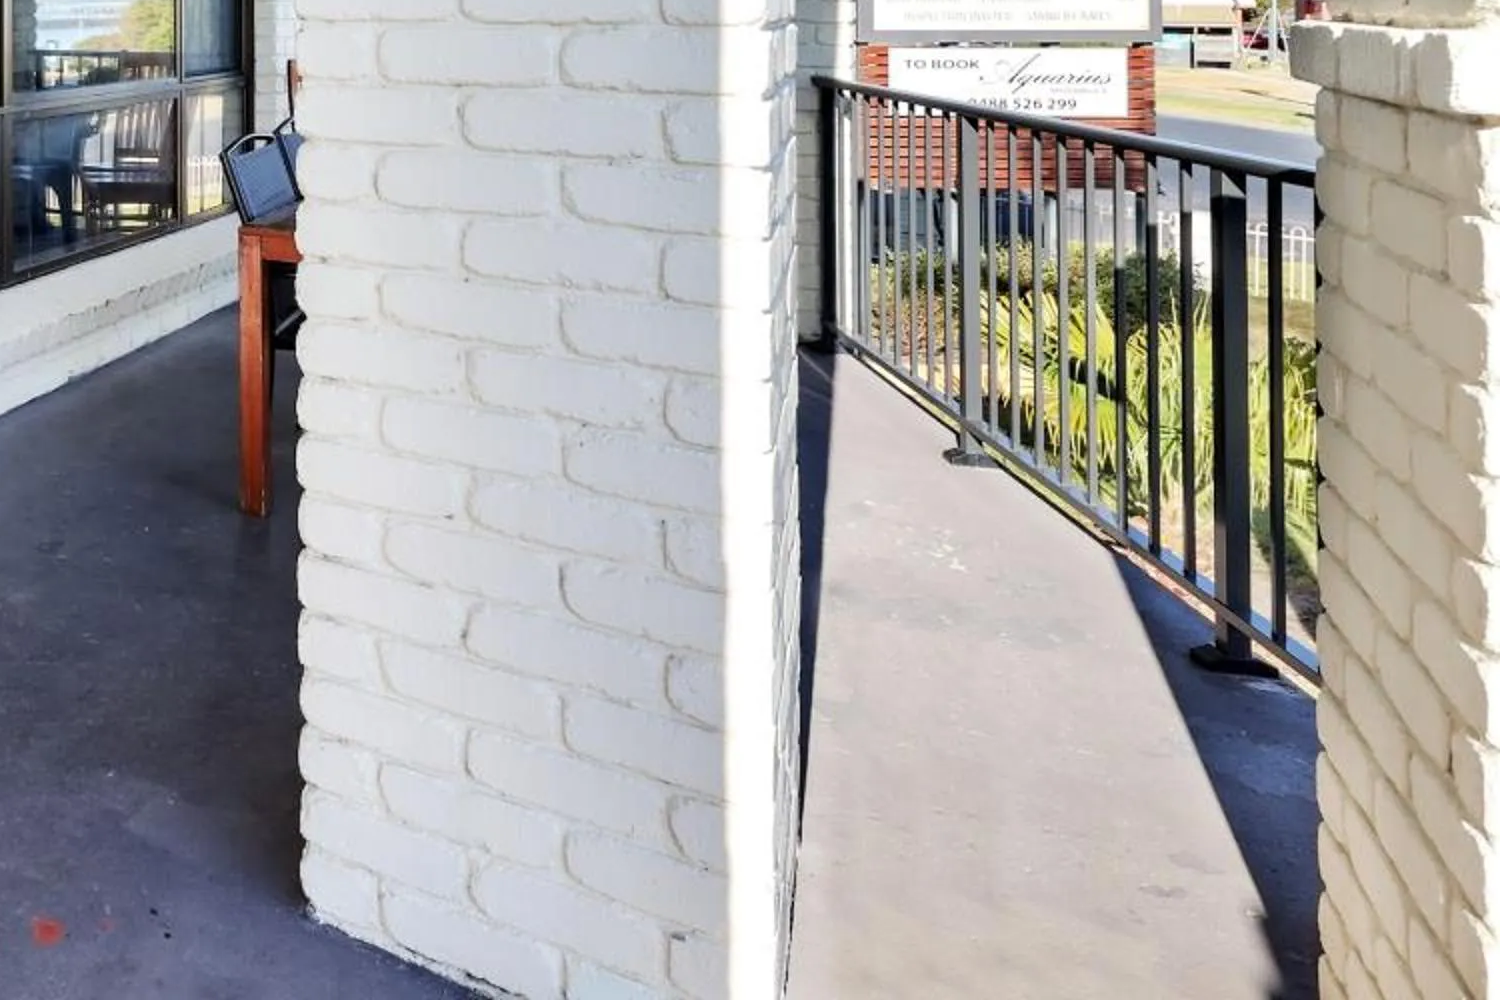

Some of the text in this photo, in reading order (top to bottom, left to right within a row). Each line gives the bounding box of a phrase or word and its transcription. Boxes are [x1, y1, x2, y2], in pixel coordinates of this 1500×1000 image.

[903, 59, 979, 69] TO BOOK
[979, 52, 1112, 94] Aquarius
[1013, 98, 1042, 109] 526
[1047, 98, 1077, 109] 299
